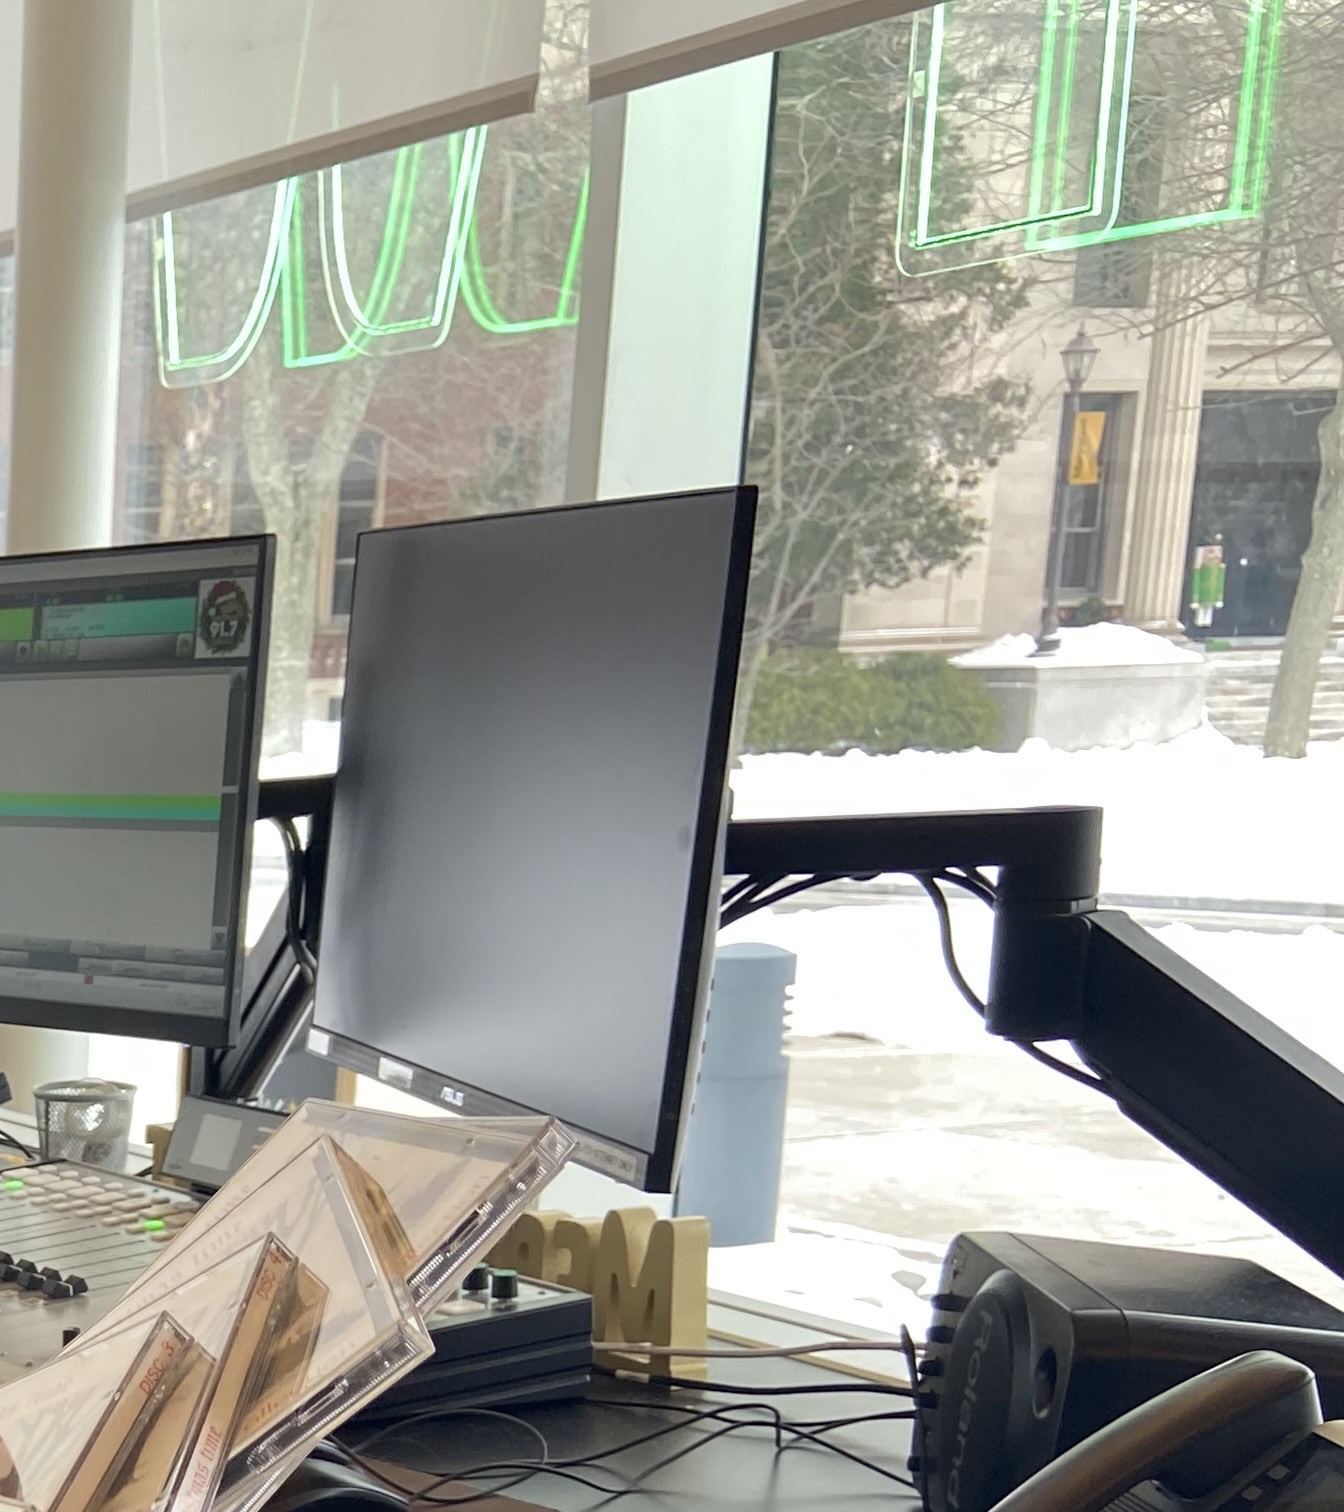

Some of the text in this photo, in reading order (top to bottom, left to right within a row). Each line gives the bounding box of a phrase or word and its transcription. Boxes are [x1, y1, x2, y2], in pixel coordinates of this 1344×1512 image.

[209, 620, 238, 638] 91.7
[255, 1268, 276, 1300] DISC
[138, 1359, 164, 1395] DISC
[947, 1310, 993, 1510] Roland
